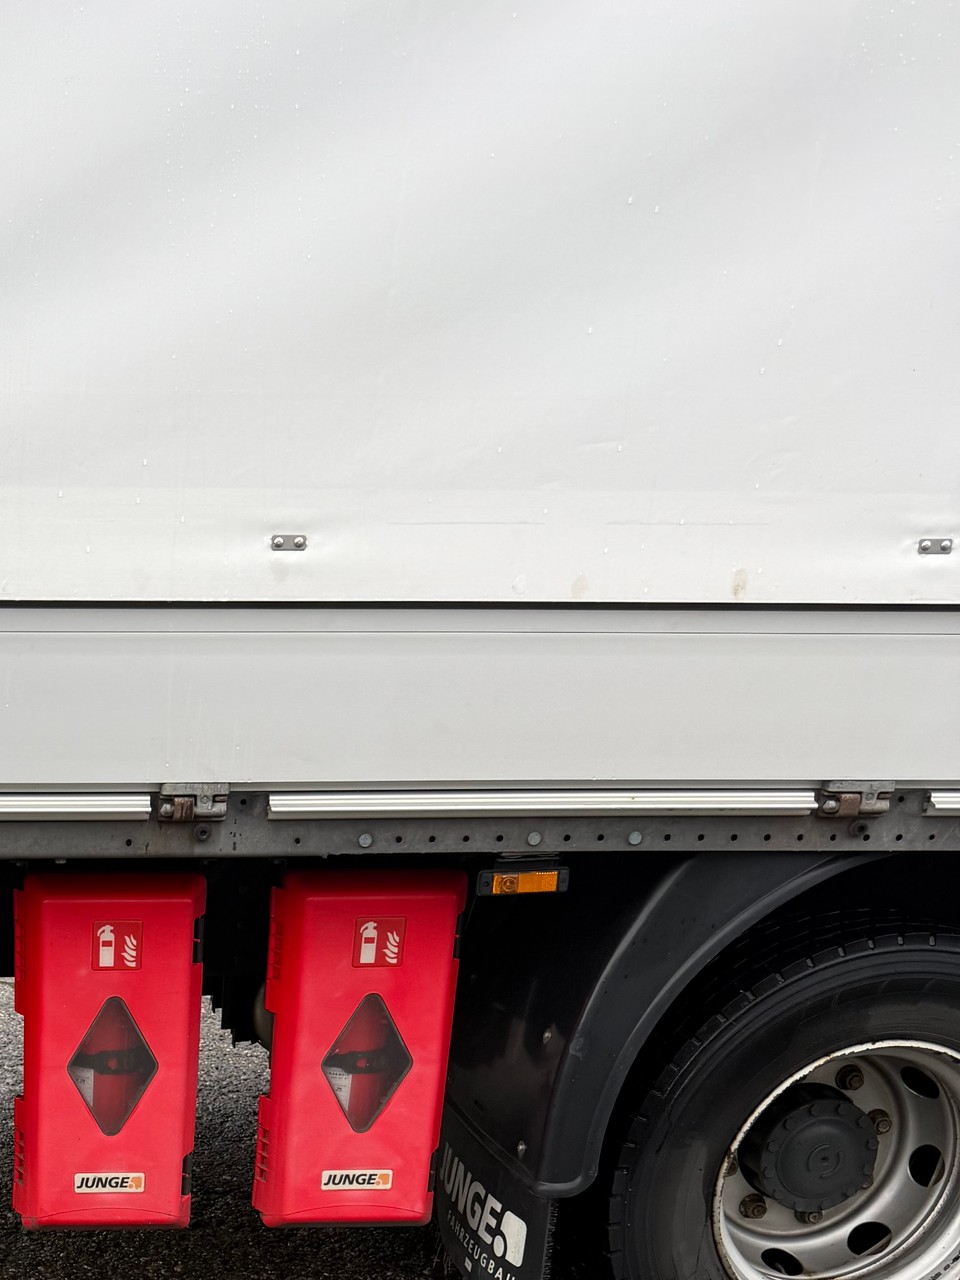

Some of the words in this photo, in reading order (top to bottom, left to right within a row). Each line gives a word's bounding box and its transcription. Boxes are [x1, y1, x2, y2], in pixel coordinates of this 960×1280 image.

[76, 1176, 130, 1189] JUNGE
[323, 1173, 378, 1186] JUNGE
[440, 1142, 503, 1245] JUNGE
